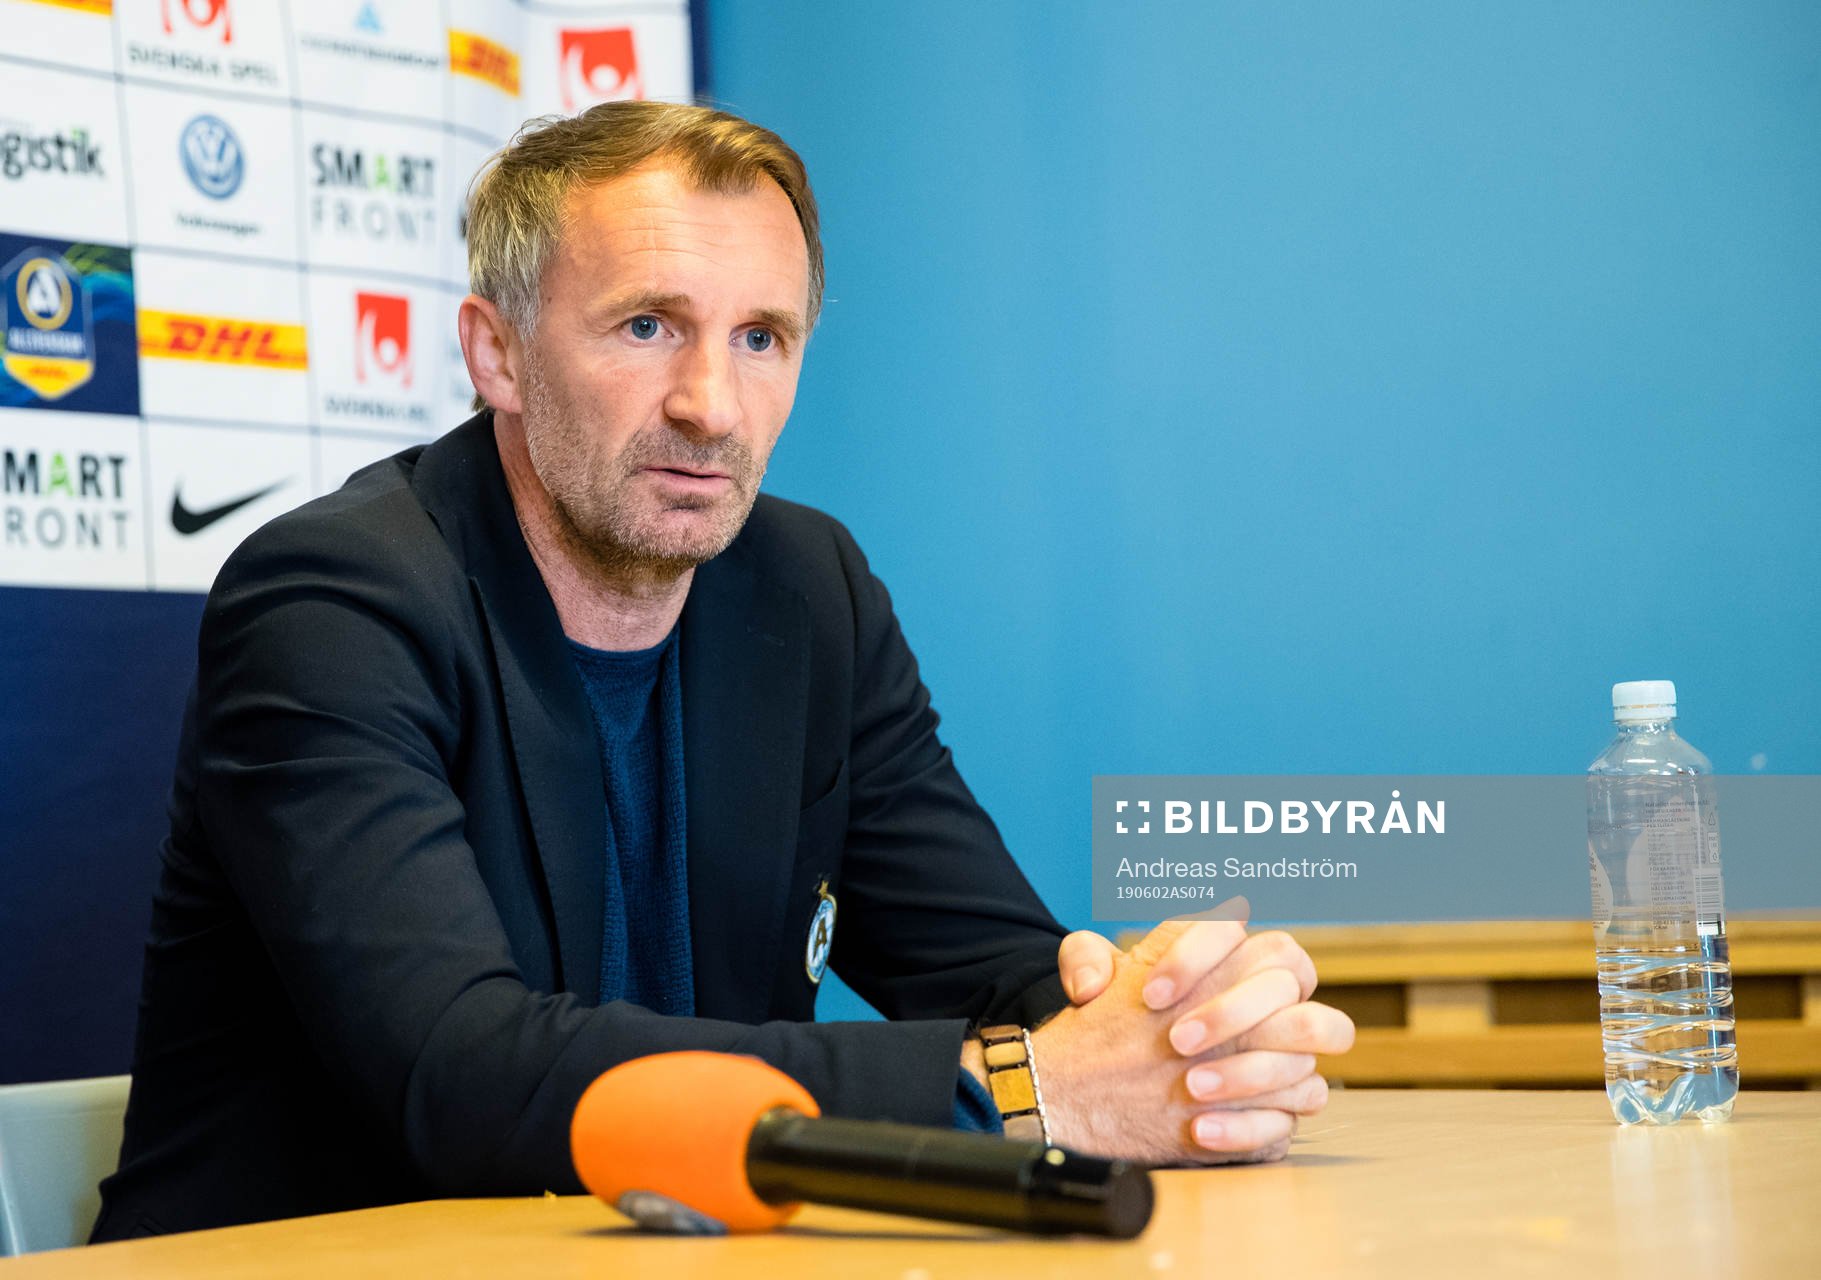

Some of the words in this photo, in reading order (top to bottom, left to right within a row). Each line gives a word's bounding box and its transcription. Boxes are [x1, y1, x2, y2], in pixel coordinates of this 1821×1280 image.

[0, 129, 104, 179] gistik
[313, 143, 435, 196] SMART
[165, 319, 282, 361] DHL
[4, 450, 126, 498] MART
[5, 505, 128, 551] RONT
